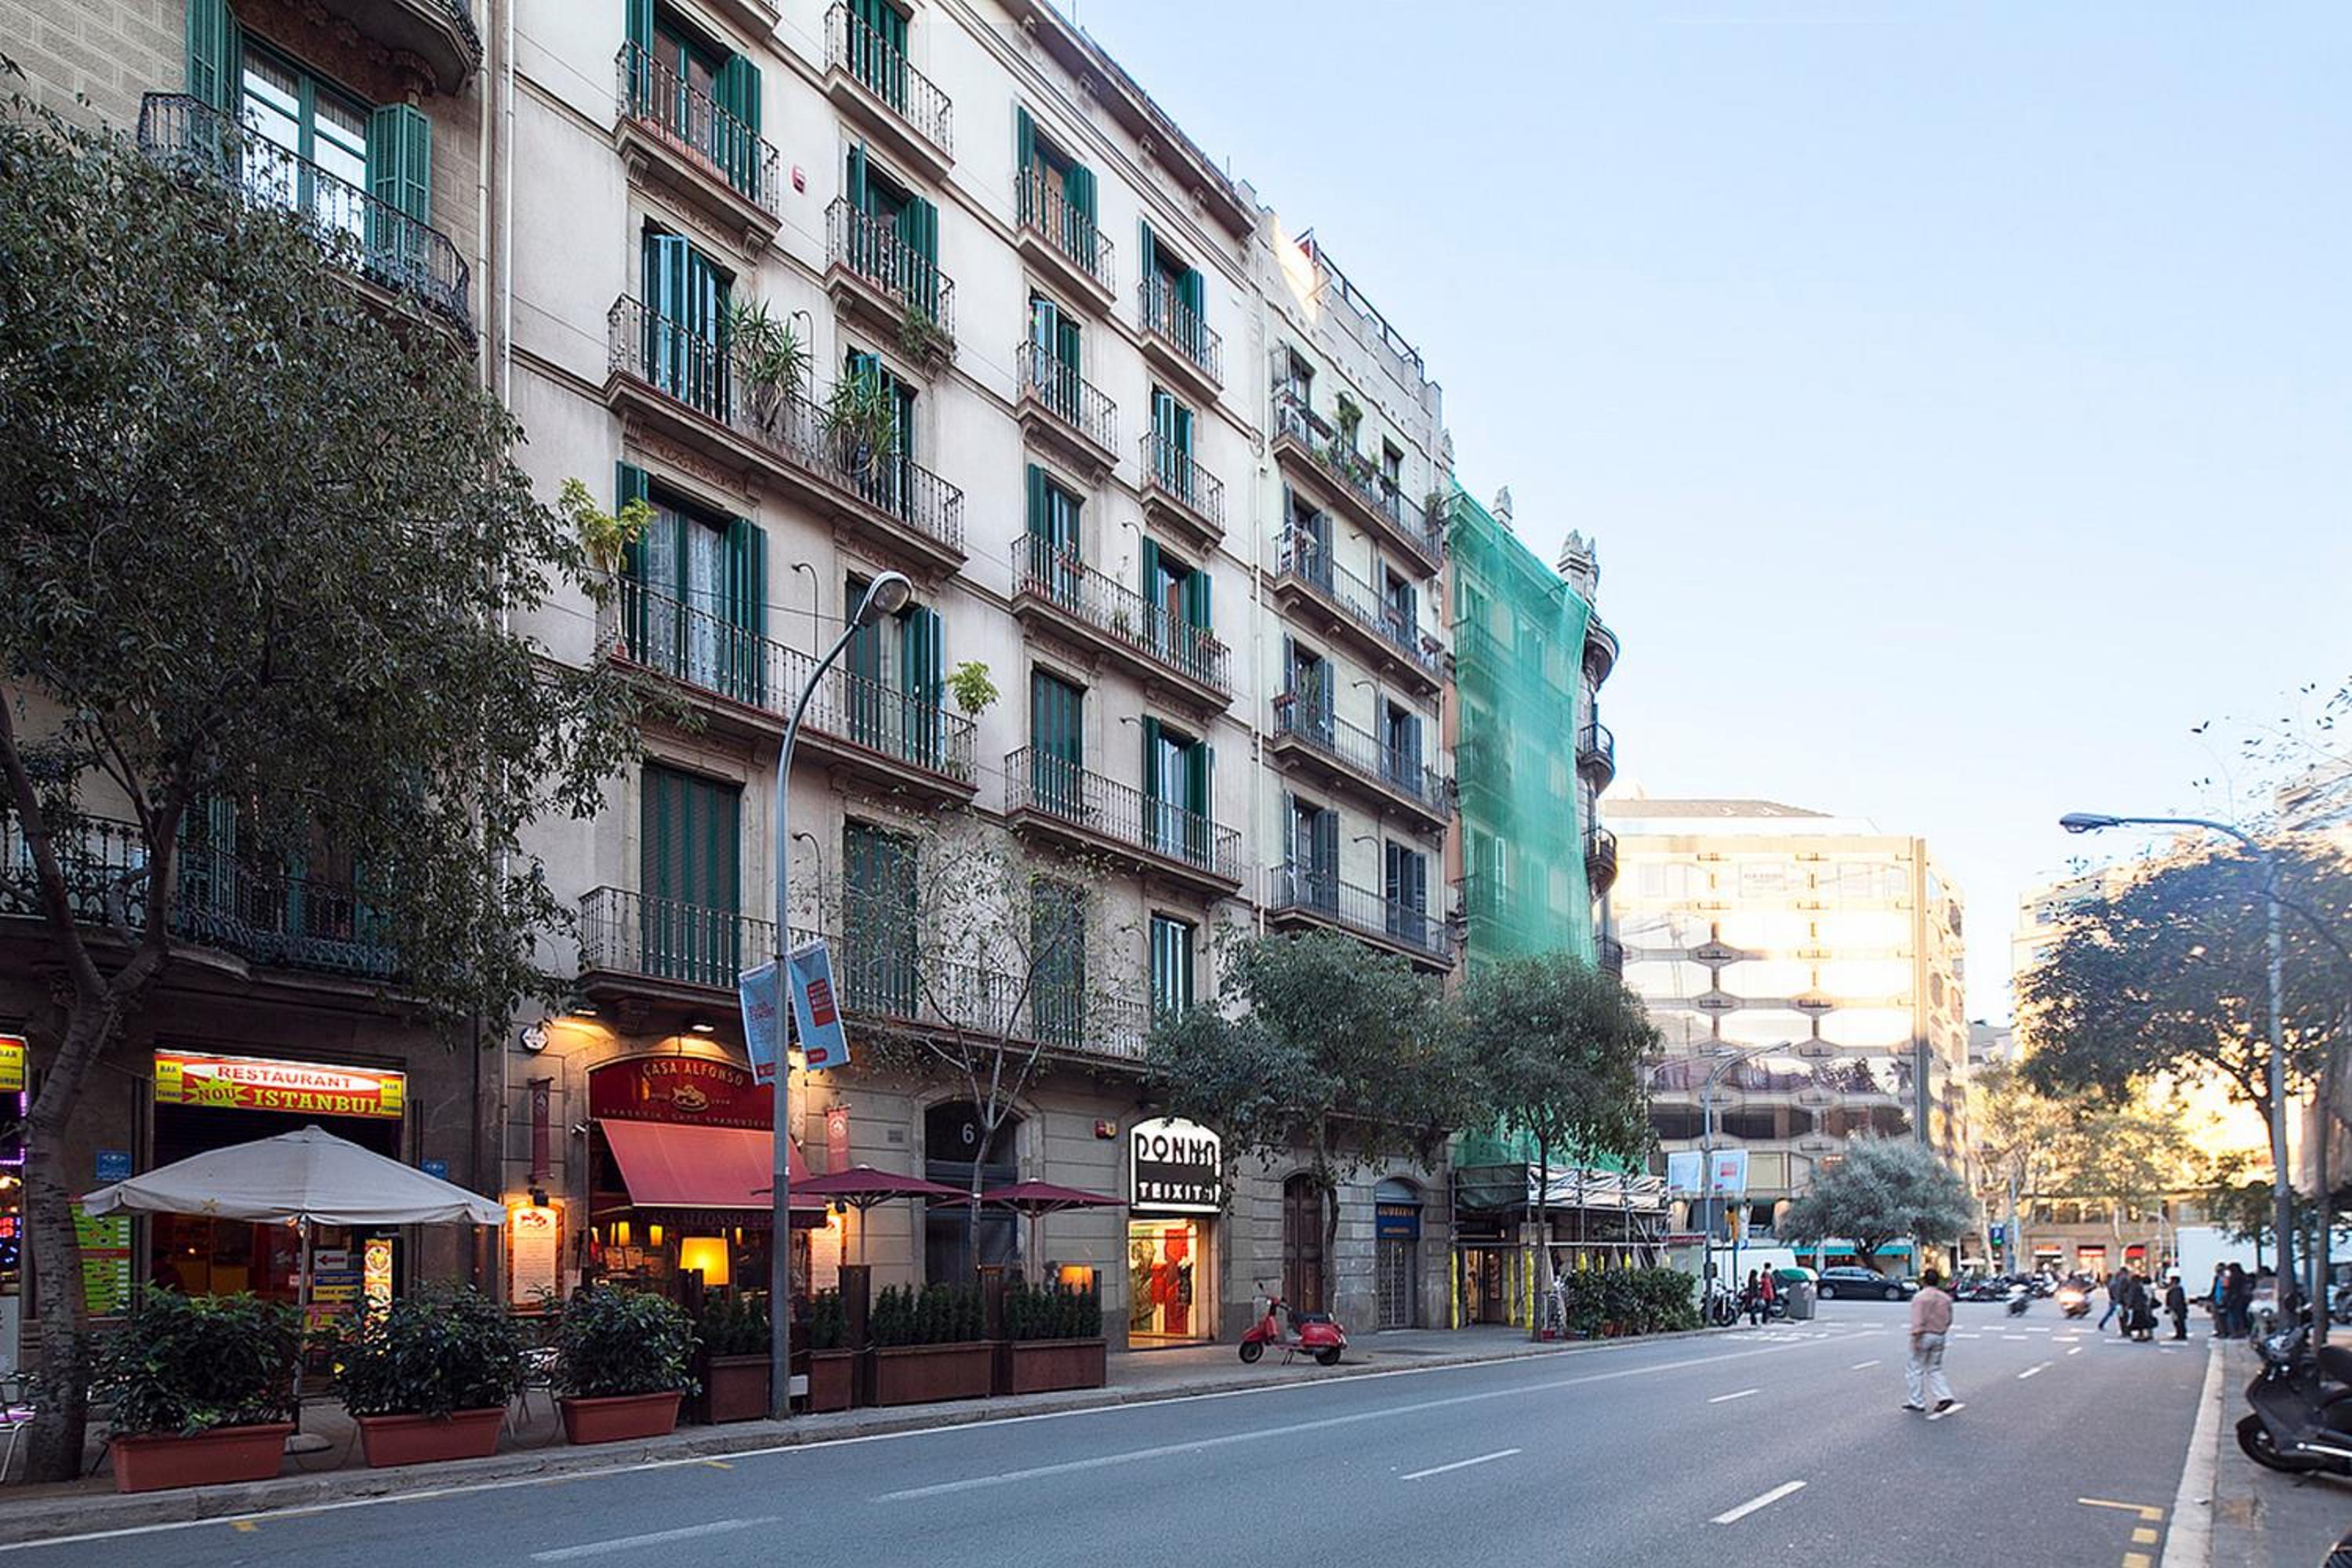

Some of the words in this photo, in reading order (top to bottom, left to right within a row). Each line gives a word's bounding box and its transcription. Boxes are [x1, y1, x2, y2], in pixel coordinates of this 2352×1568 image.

[160, 1065, 177, 1073] BAR
[217, 1065, 351, 1089] RESTAURANT
[642, 1062, 677, 1077] CASA
[684, 1062, 744, 1087] ALFONSO
[198, 1087, 236, 1102] NOU
[254, 1088, 382, 1113] ISTANBUL
[962, 1123, 975, 1145] 6
